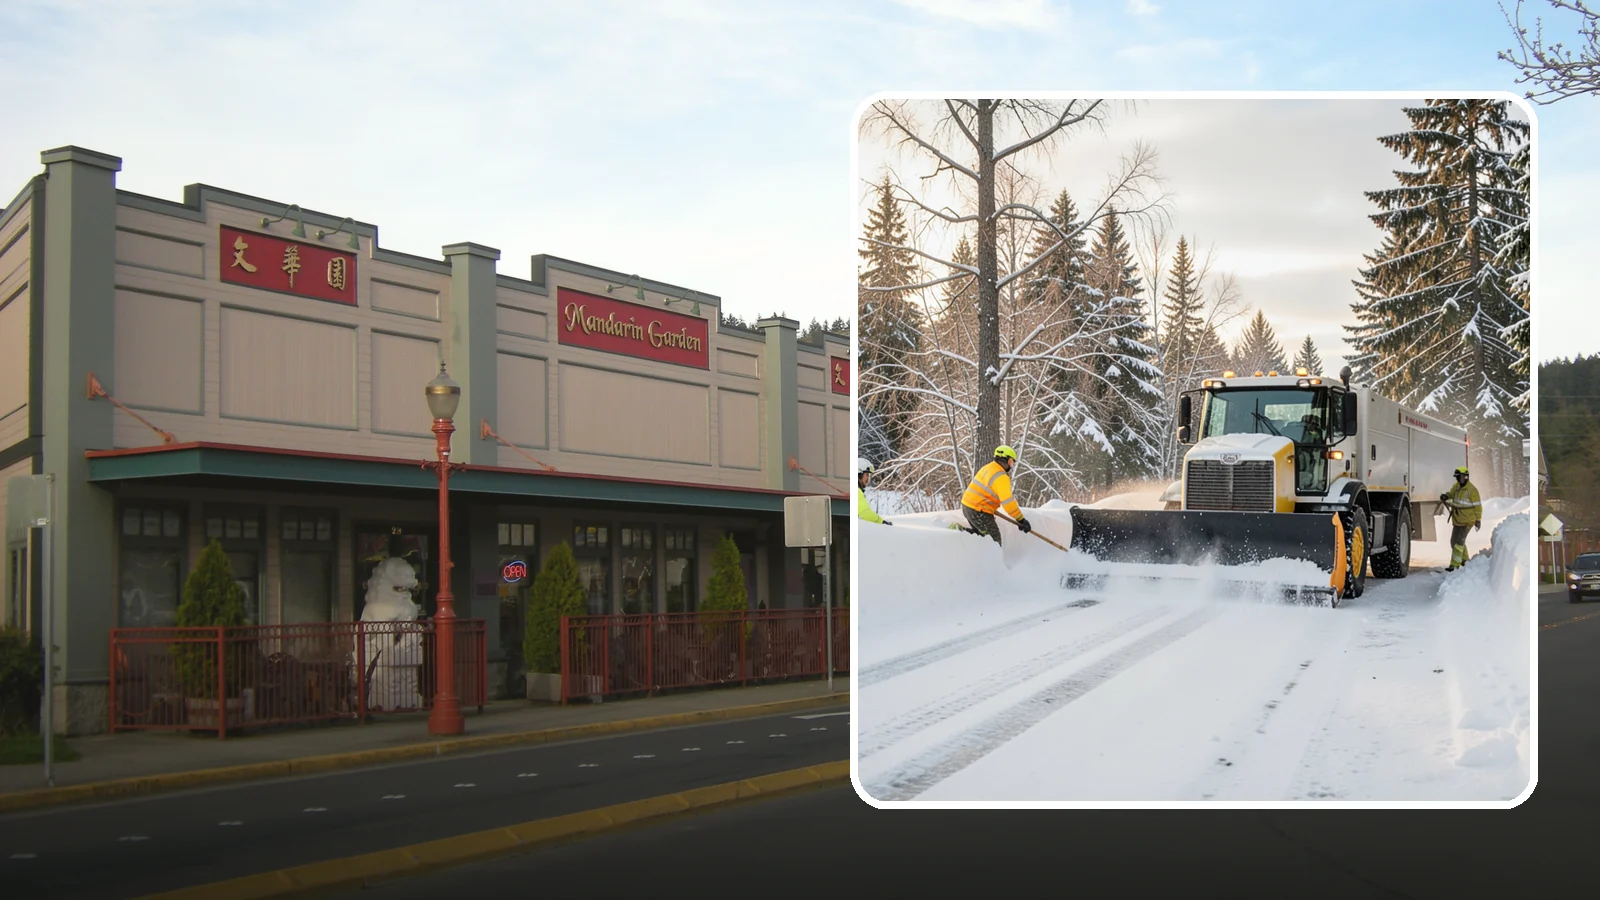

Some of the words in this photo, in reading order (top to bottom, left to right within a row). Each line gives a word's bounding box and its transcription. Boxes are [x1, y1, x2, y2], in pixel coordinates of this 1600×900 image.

[230, 235, 346, 291] 文華園
[564, 302, 644, 341] Mandarin
[647, 320, 701, 352] Garden
[503, 565, 527, 578] OPEN
